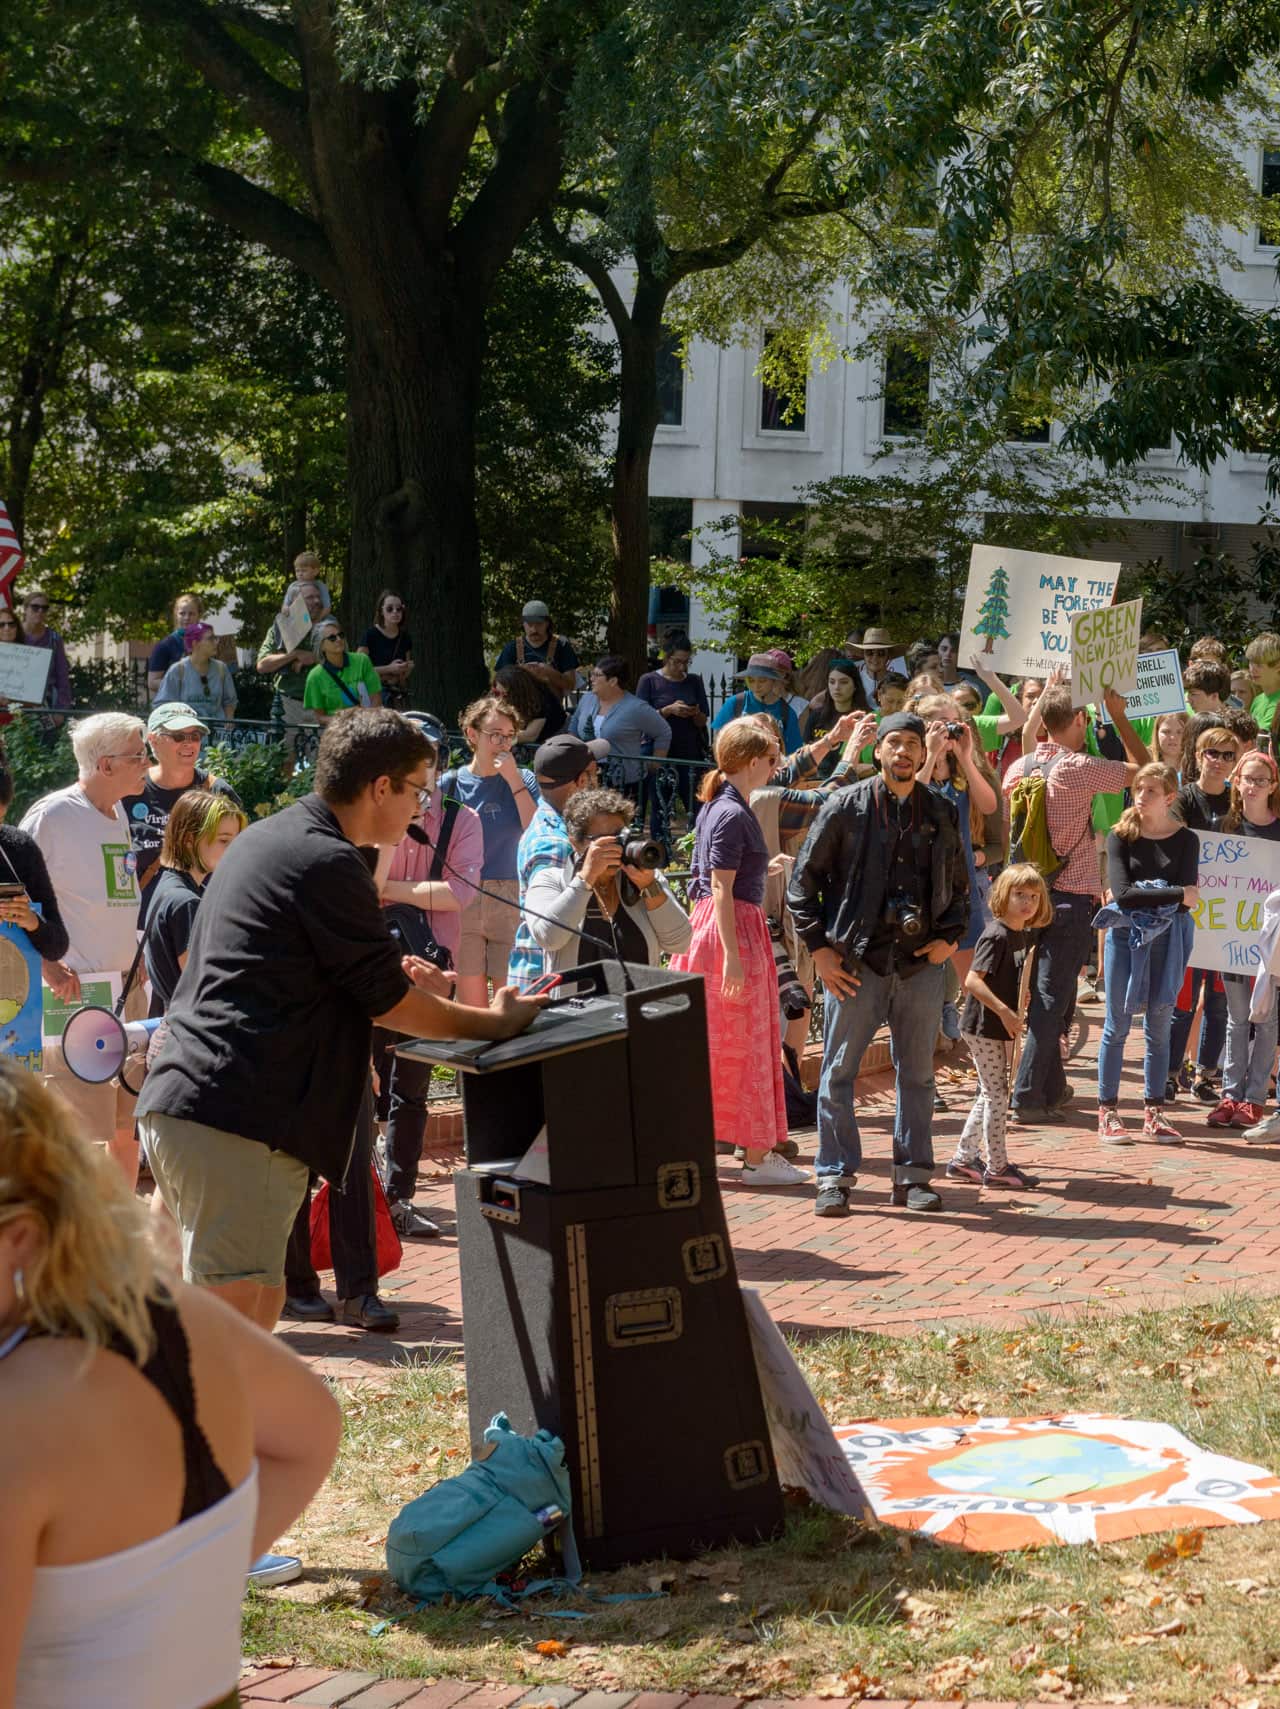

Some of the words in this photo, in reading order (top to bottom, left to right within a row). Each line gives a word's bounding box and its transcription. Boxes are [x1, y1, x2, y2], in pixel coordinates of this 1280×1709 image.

[1040, 574, 1078, 593] MAY
[1087, 580, 1115, 597] THE
[1054, 594, 1104, 611] FOREST
[1042, 608, 1057, 625] BE
[1075, 604, 1137, 645] GREEN
[1074, 642, 1107, 668] NEW
[1108, 633, 1136, 657] DEAL
[1136, 659, 1167, 673] RRELL:
[1079, 657, 1135, 696] NOW
[1136, 673, 1176, 690] CHIEVING
[1125, 695, 1142, 709] FOR
[144, 814, 170, 825] Virgi
[143, 839, 160, 848] for
[1199, 839, 1250, 864] EASE
[1196, 873, 1245, 889] DON'T
[1222, 940, 1262, 966] THIS
